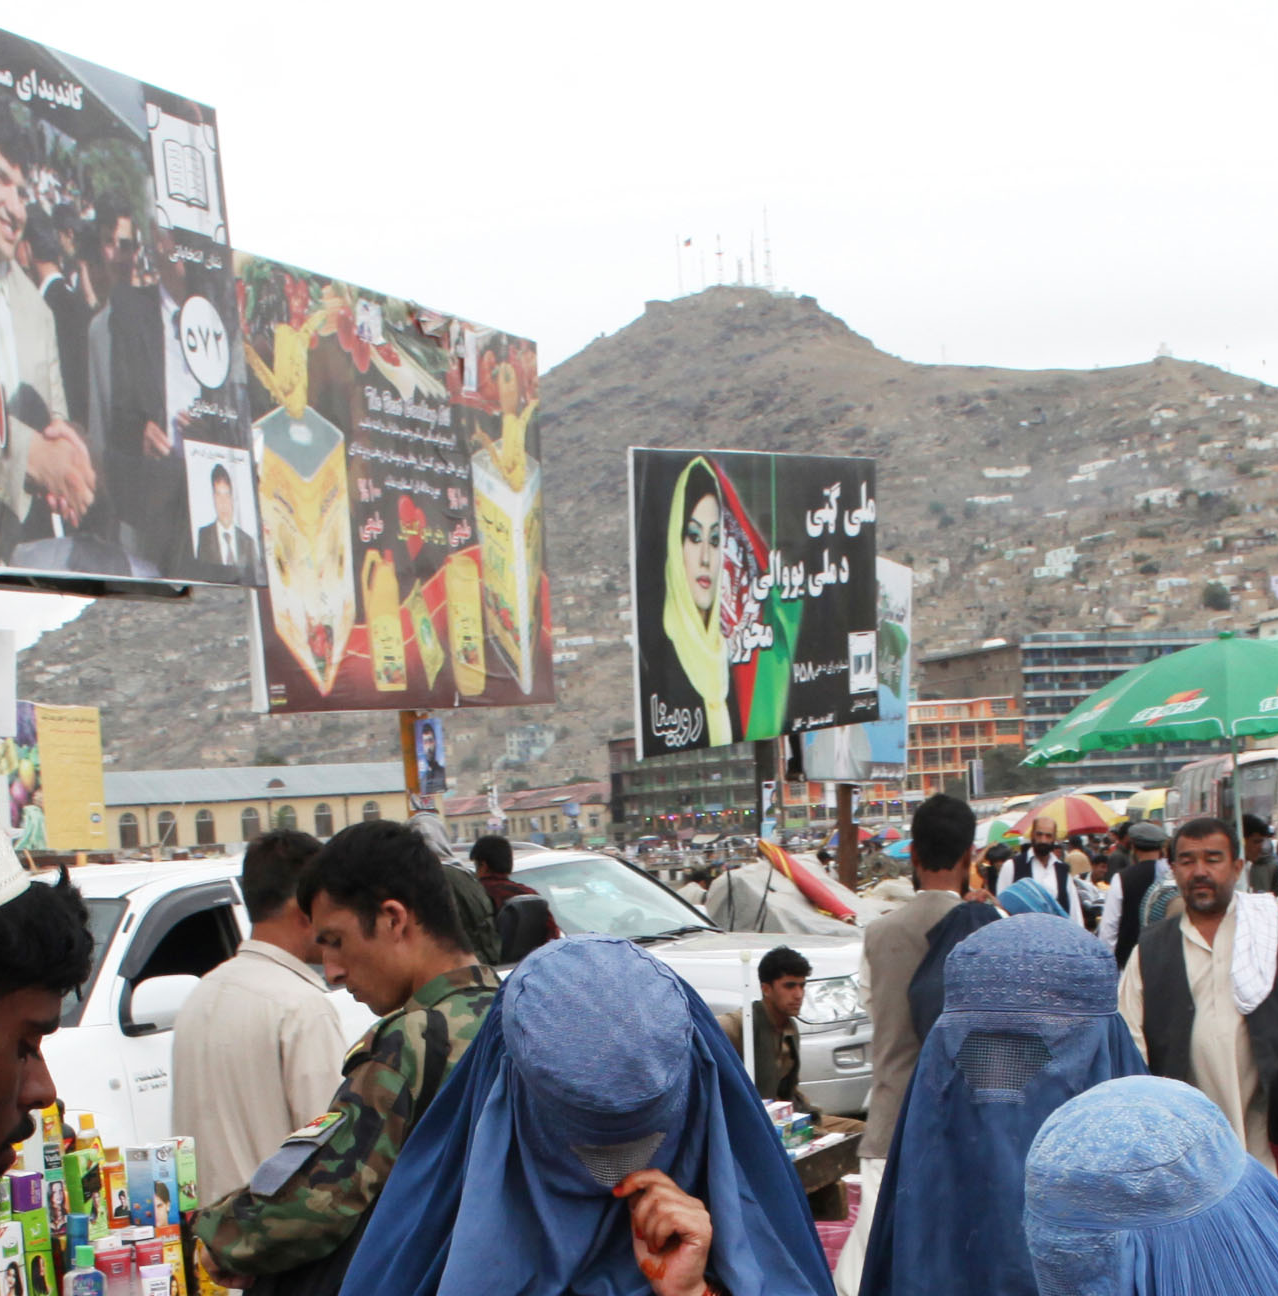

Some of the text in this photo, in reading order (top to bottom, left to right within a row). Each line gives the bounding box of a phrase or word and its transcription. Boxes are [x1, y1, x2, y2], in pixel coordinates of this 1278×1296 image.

[16, 69, 84, 110] کاندیدای
[843, 481, 876, 536] ملی
[808, 549, 837, 598] ملی
